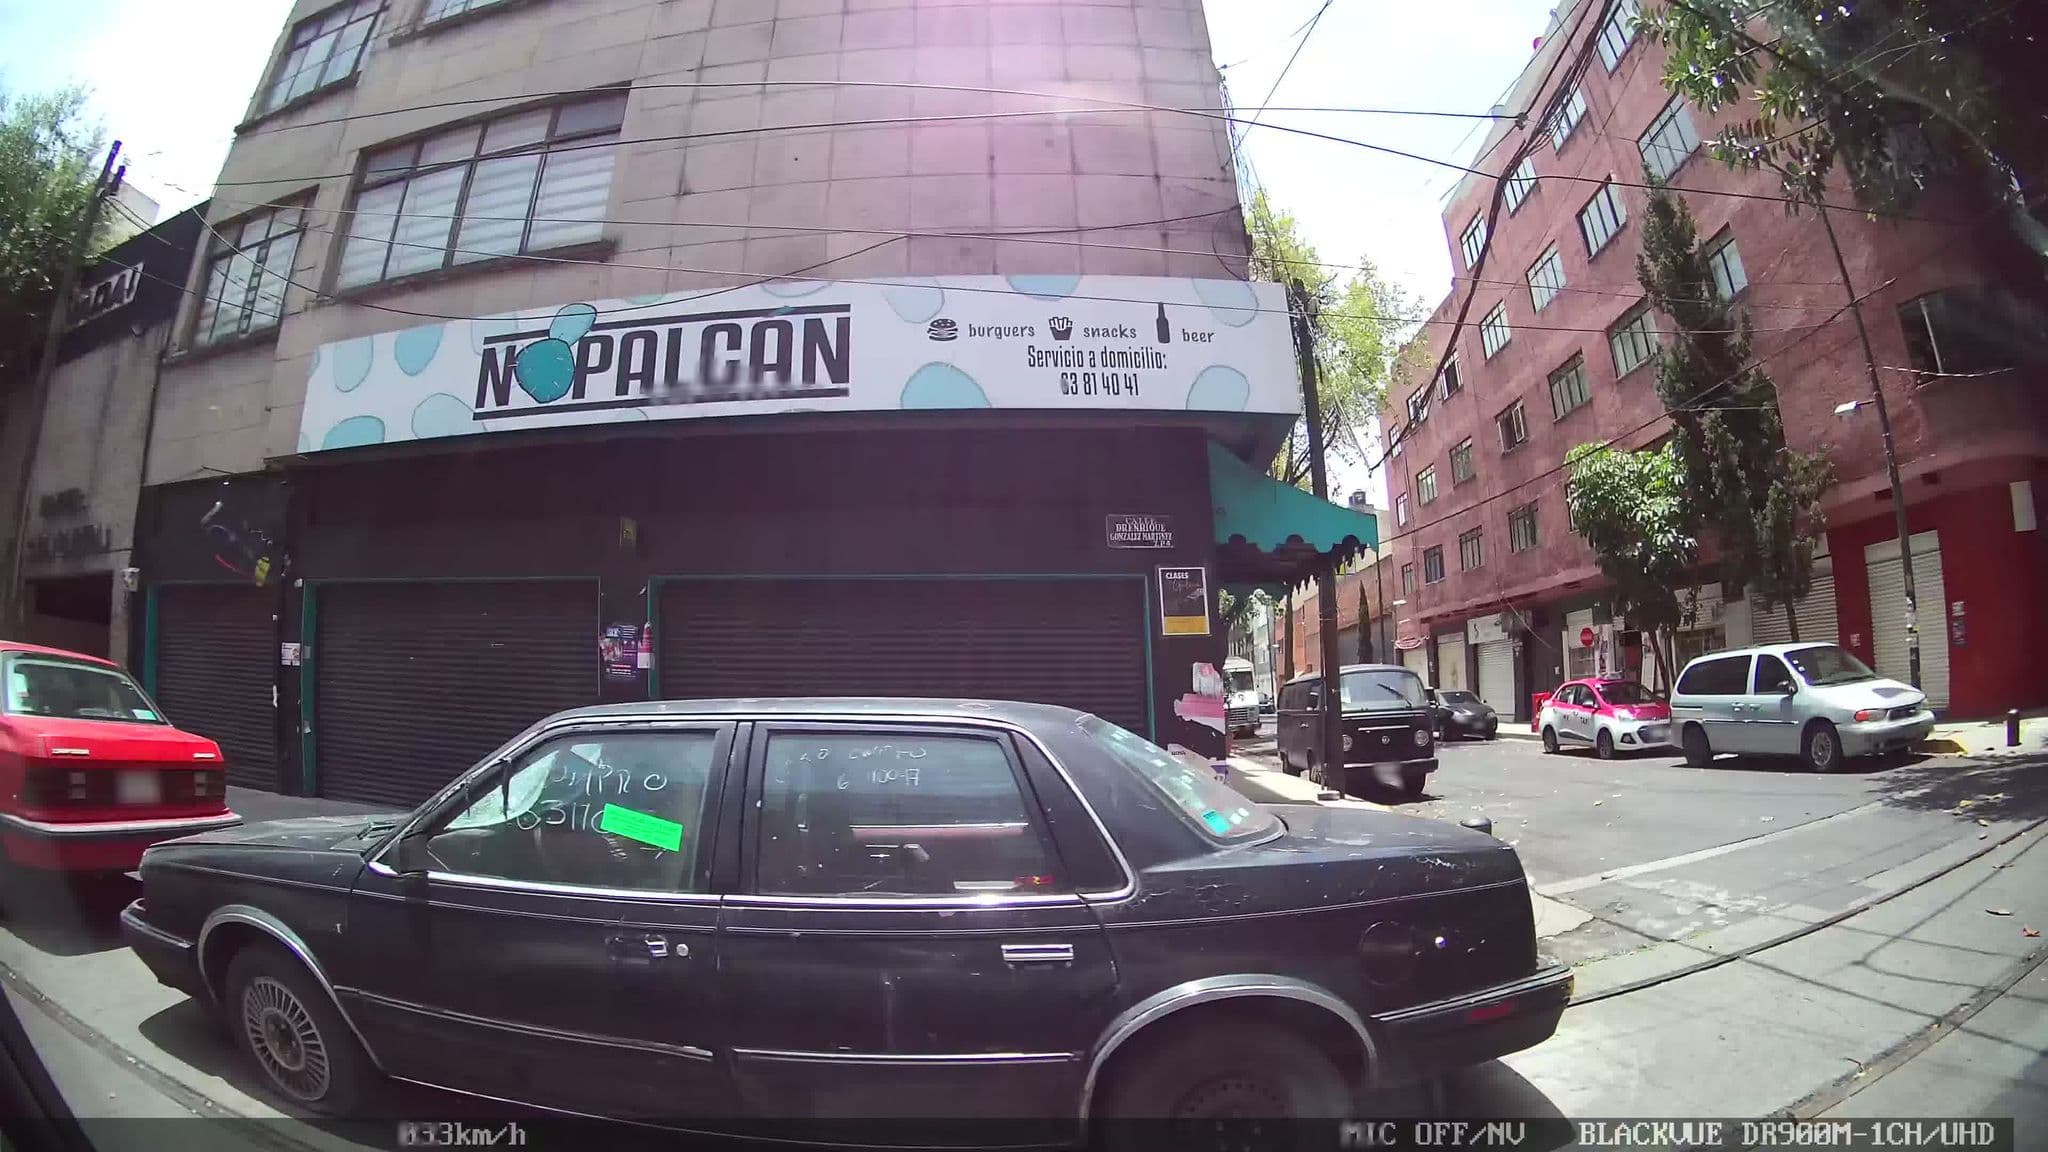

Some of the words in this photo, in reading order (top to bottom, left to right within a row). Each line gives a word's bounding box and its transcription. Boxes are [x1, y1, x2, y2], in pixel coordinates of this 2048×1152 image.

[968, 324, 1036, 340] burguers
[1083, 324, 1138, 338] snacks
[1182, 328, 1216, 343] beer
[1027, 345, 1084, 368] Servicio
[1088, 350, 1097, 368] a
[1100, 345, 1168, 369] domicilio:
[1082, 372, 1098, 396] 81
[1101, 372, 1120, 396] 40
[1123, 372, 1139, 396] 41
[1165, 572, 1189, 580] CLASES
